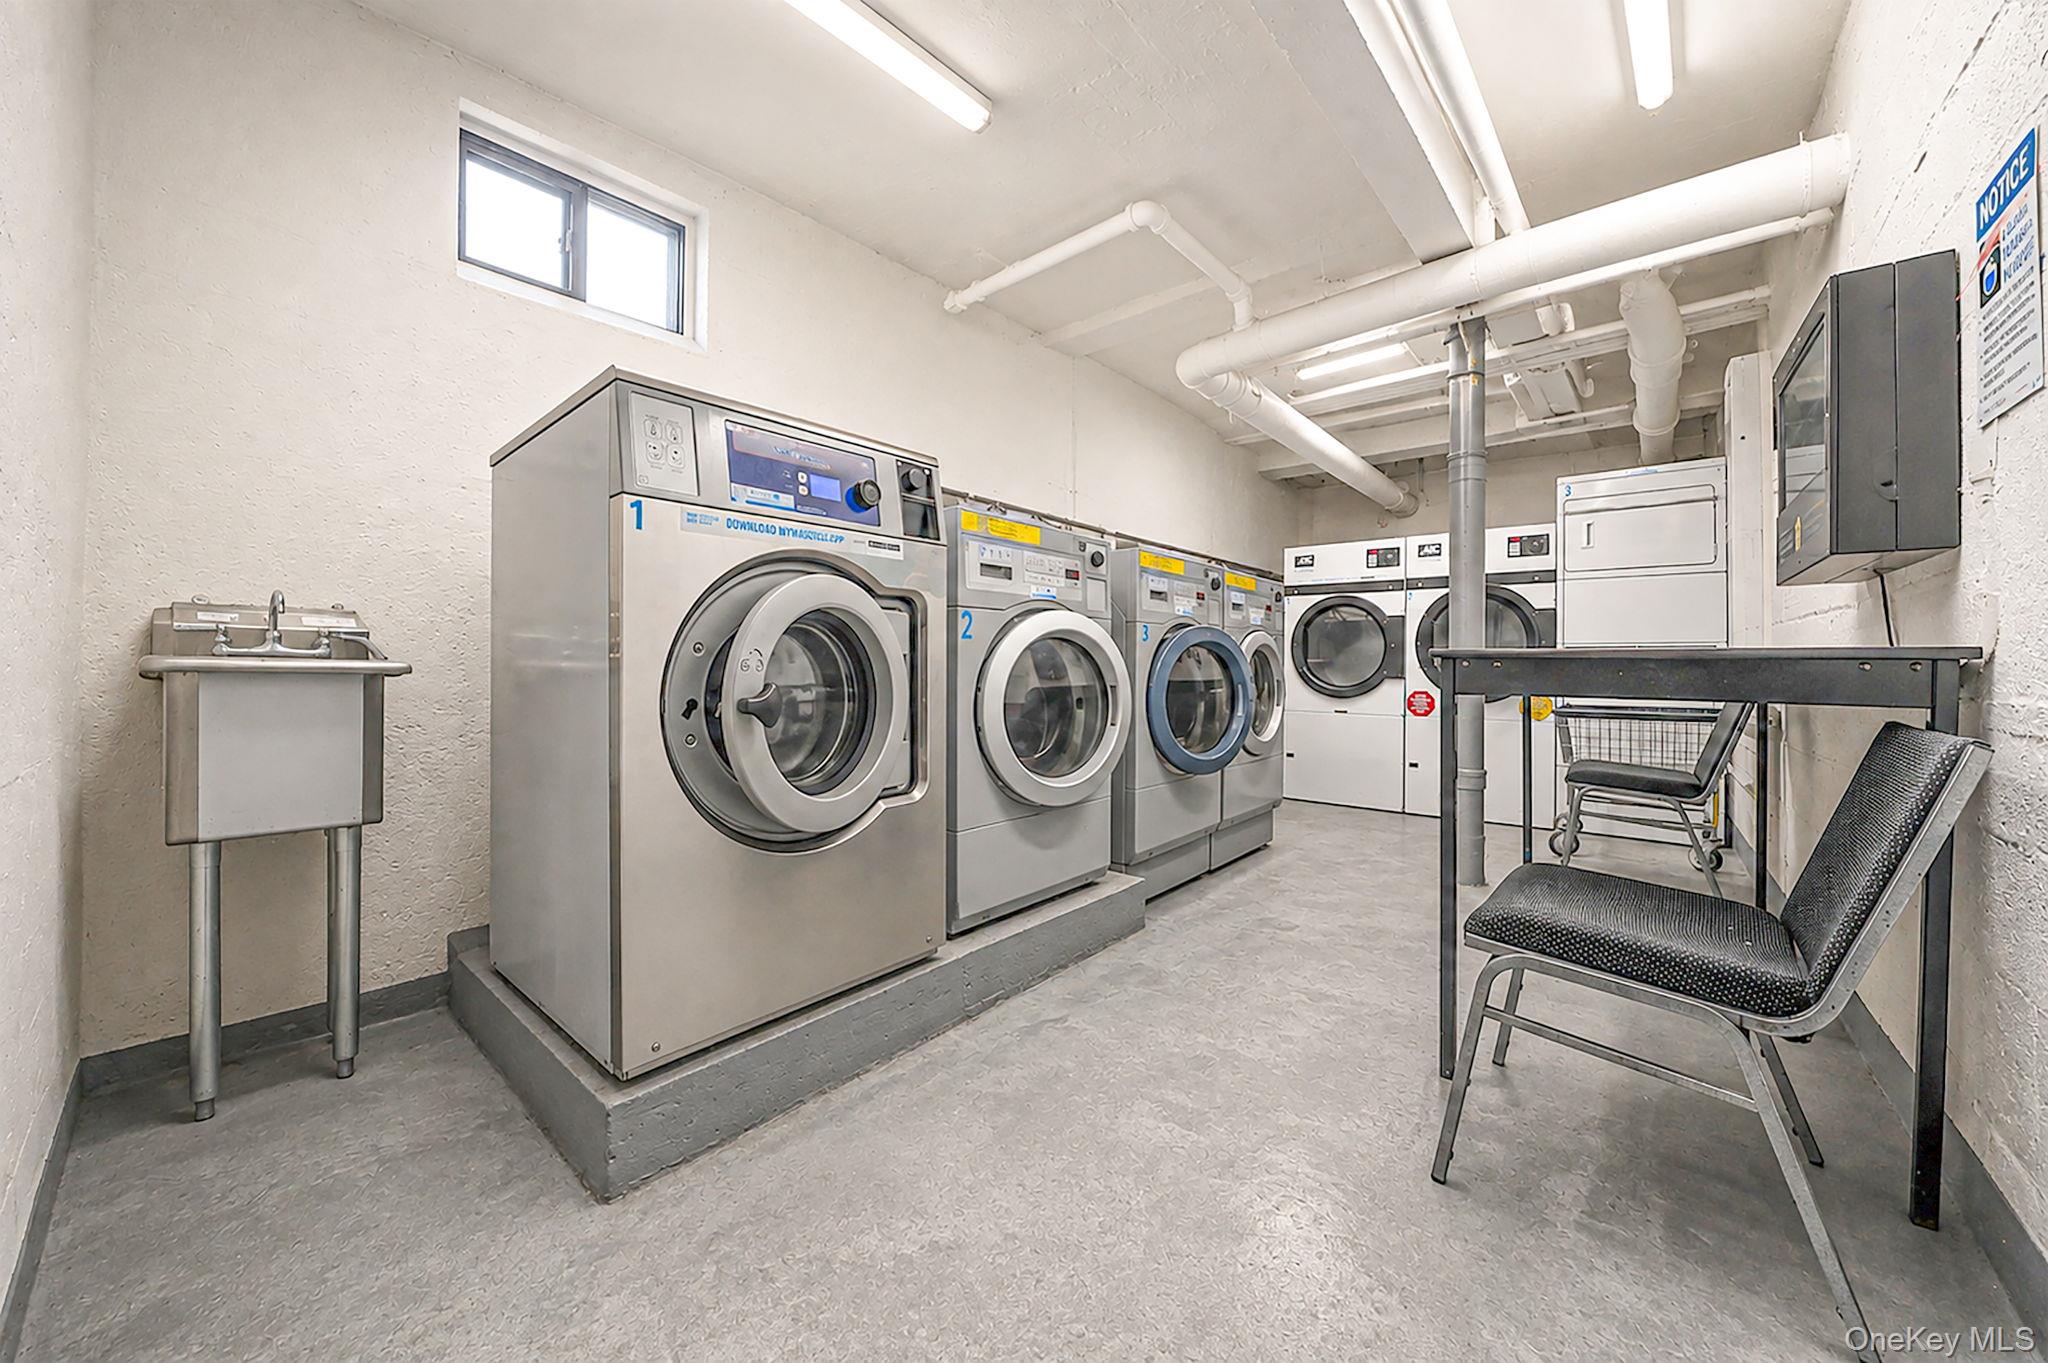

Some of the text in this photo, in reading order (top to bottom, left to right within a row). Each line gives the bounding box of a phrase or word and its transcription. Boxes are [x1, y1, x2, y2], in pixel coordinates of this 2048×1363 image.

[1979, 143, 2031, 230] NOTICE
[1564, 484, 1572, 497] 3
[629, 500, 644, 530] 1
[726, 517, 777, 535] DOWNLOAD
[960, 610, 973, 640] 2
[1142, 624, 1150, 642] 3
